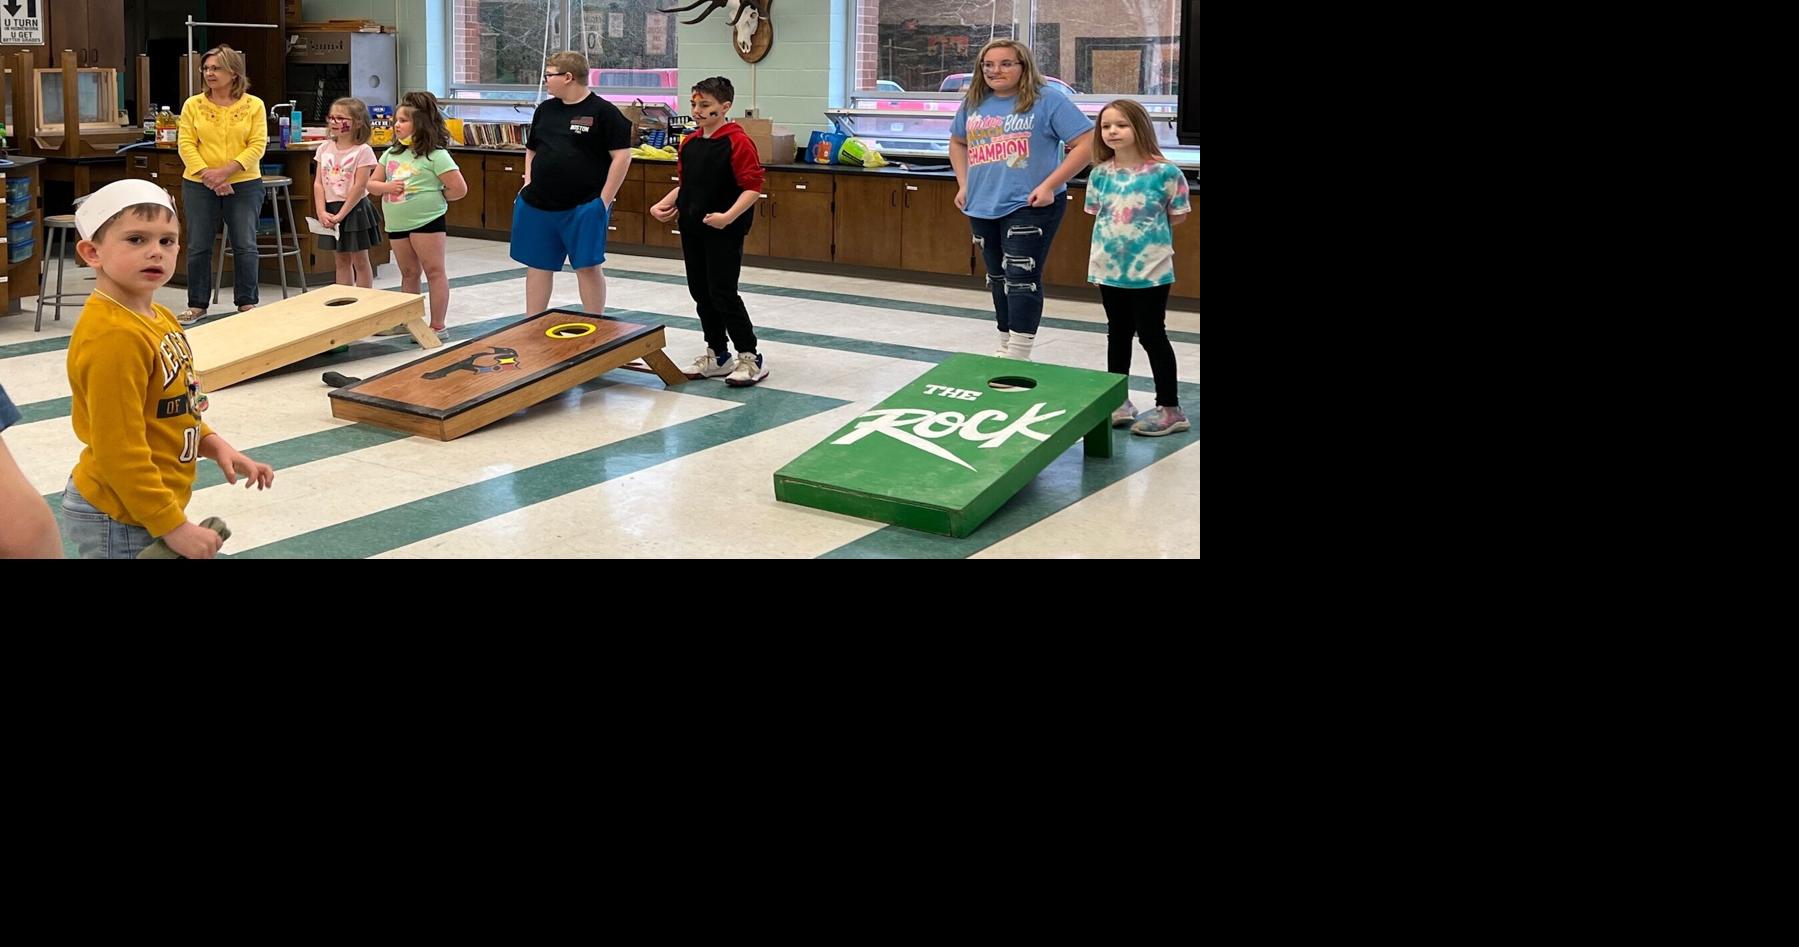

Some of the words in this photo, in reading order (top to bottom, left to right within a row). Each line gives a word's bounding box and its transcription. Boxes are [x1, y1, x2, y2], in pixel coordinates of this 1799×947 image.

[4, 18, 10, 26] U
[13, 18, 38, 26] TURN
[1003, 113, 1034, 132] Blast
[968, 139, 1029, 167] CHAMPION
[923, 384, 983, 401] THE
[166, 399, 180, 415] OF
[830, 402, 1067, 473] ROCK
